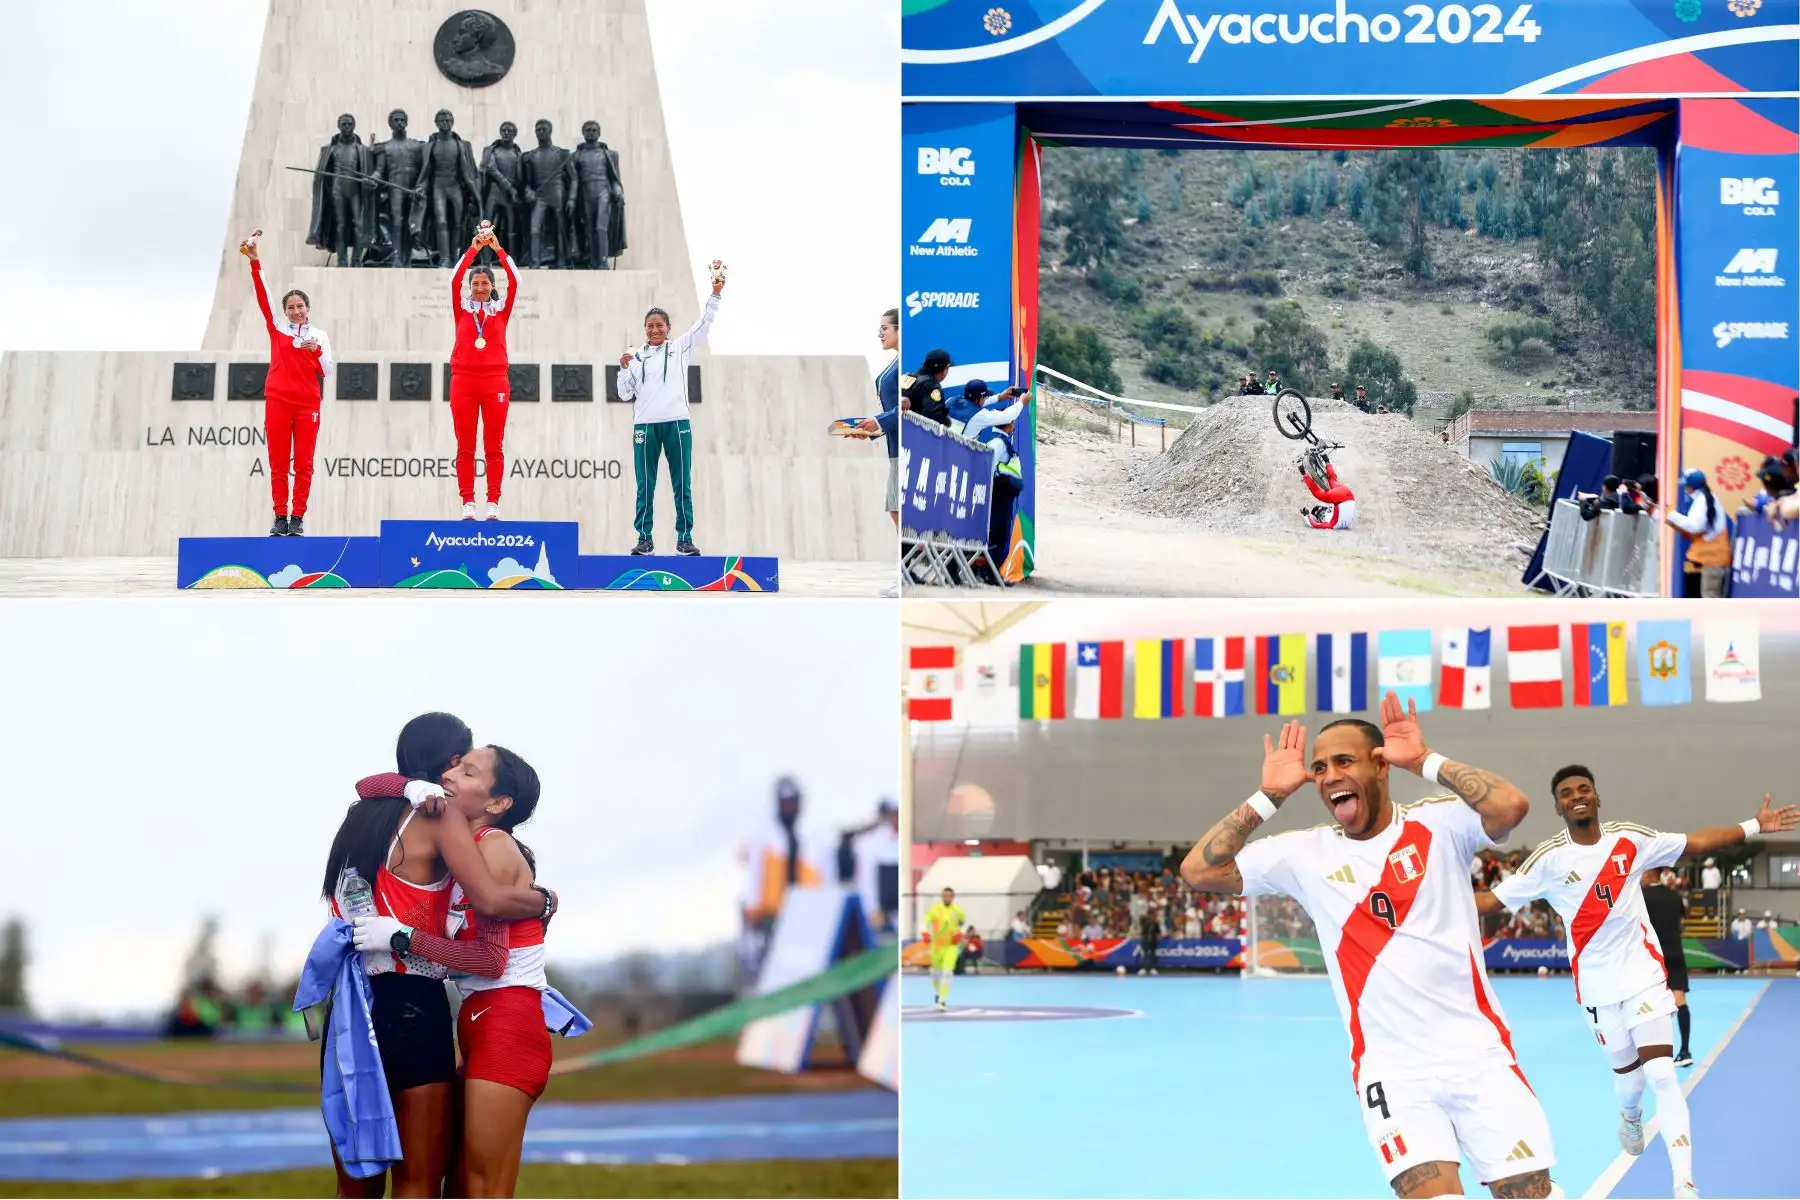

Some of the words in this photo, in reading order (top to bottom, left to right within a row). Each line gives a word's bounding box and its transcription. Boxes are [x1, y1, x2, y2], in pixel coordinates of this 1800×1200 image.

[917, 147, 976, 176] BIG
[939, 177, 971, 186] COLA
[1719, 177, 1780, 206] BIG
[1742, 207, 1776, 216] COLA
[909, 245, 935, 256] New
[936, 245, 978, 257] Athletic
[146, 426, 175, 446] LA
[188, 426, 266, 446] NACION
[249, 457, 265, 477] A
[509, 459, 622, 479] AYACUCHO
[425, 531, 535, 551] Ayacucho2024
[1594, 883, 1614, 909] 4
[1369, 891, 1397, 929] 9
[1366, 1081, 1391, 1120] 9
